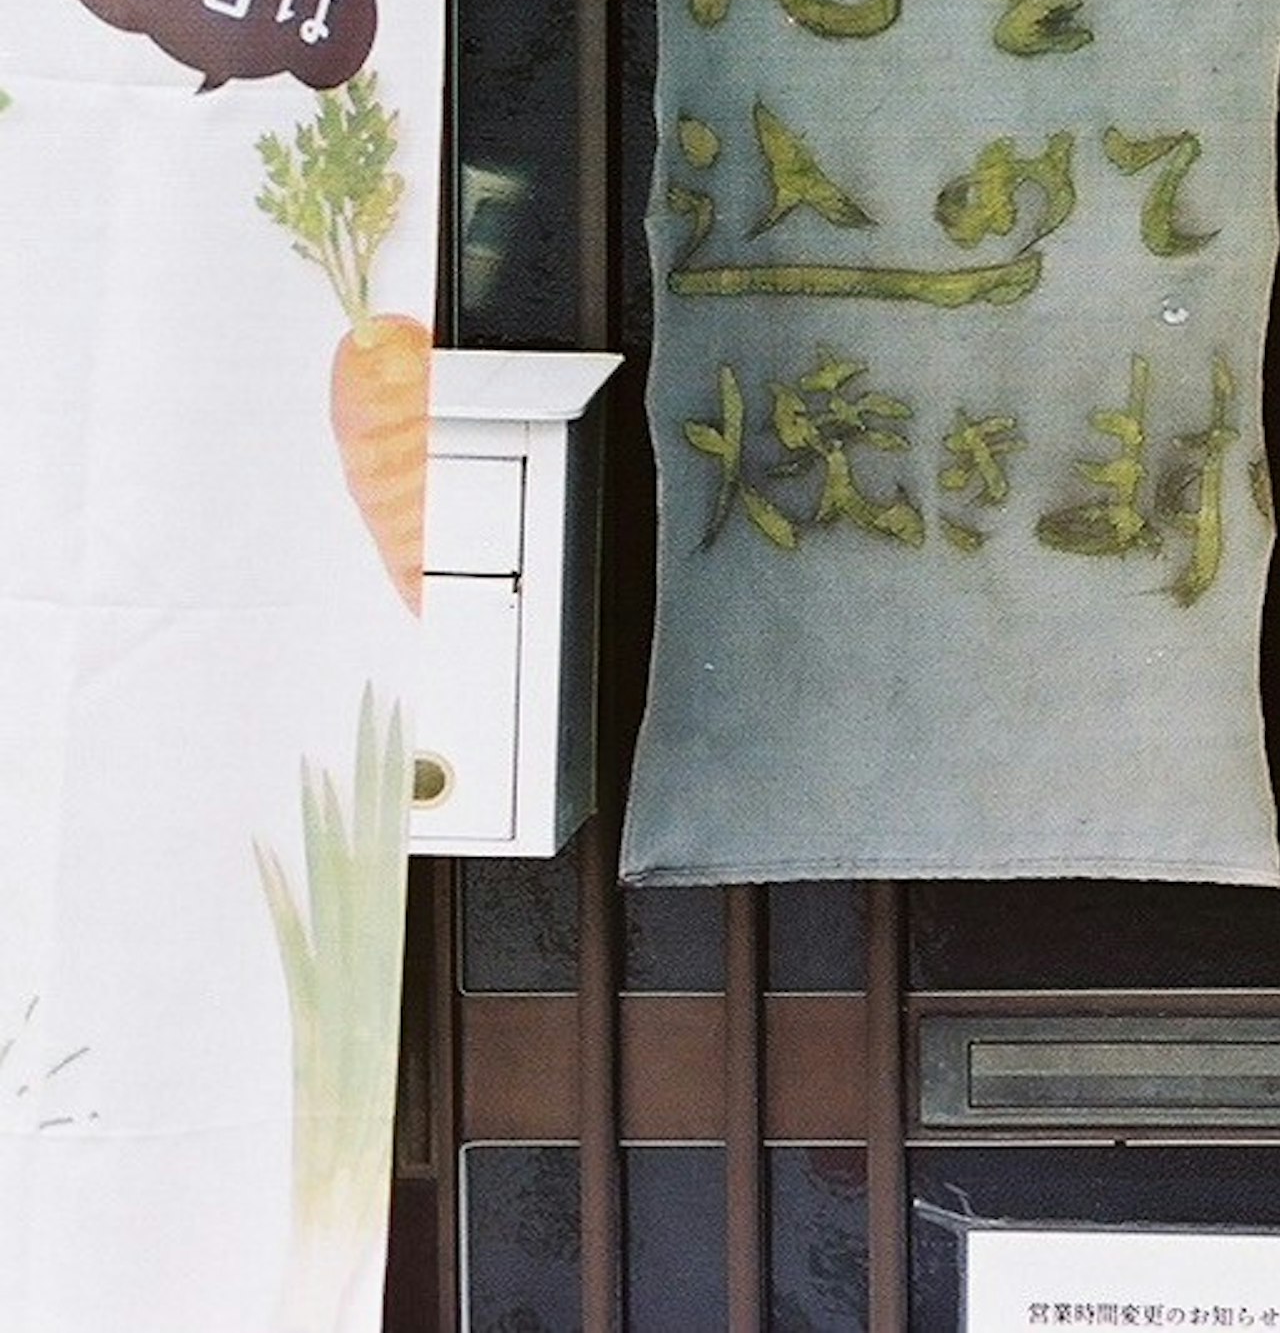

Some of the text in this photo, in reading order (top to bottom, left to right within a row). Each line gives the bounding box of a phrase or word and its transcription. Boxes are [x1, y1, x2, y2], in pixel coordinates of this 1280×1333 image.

[668, 99, 1222, 308] 込めて
[1027, 1302, 1280, 1328] 営業時間変更のお知らせ
